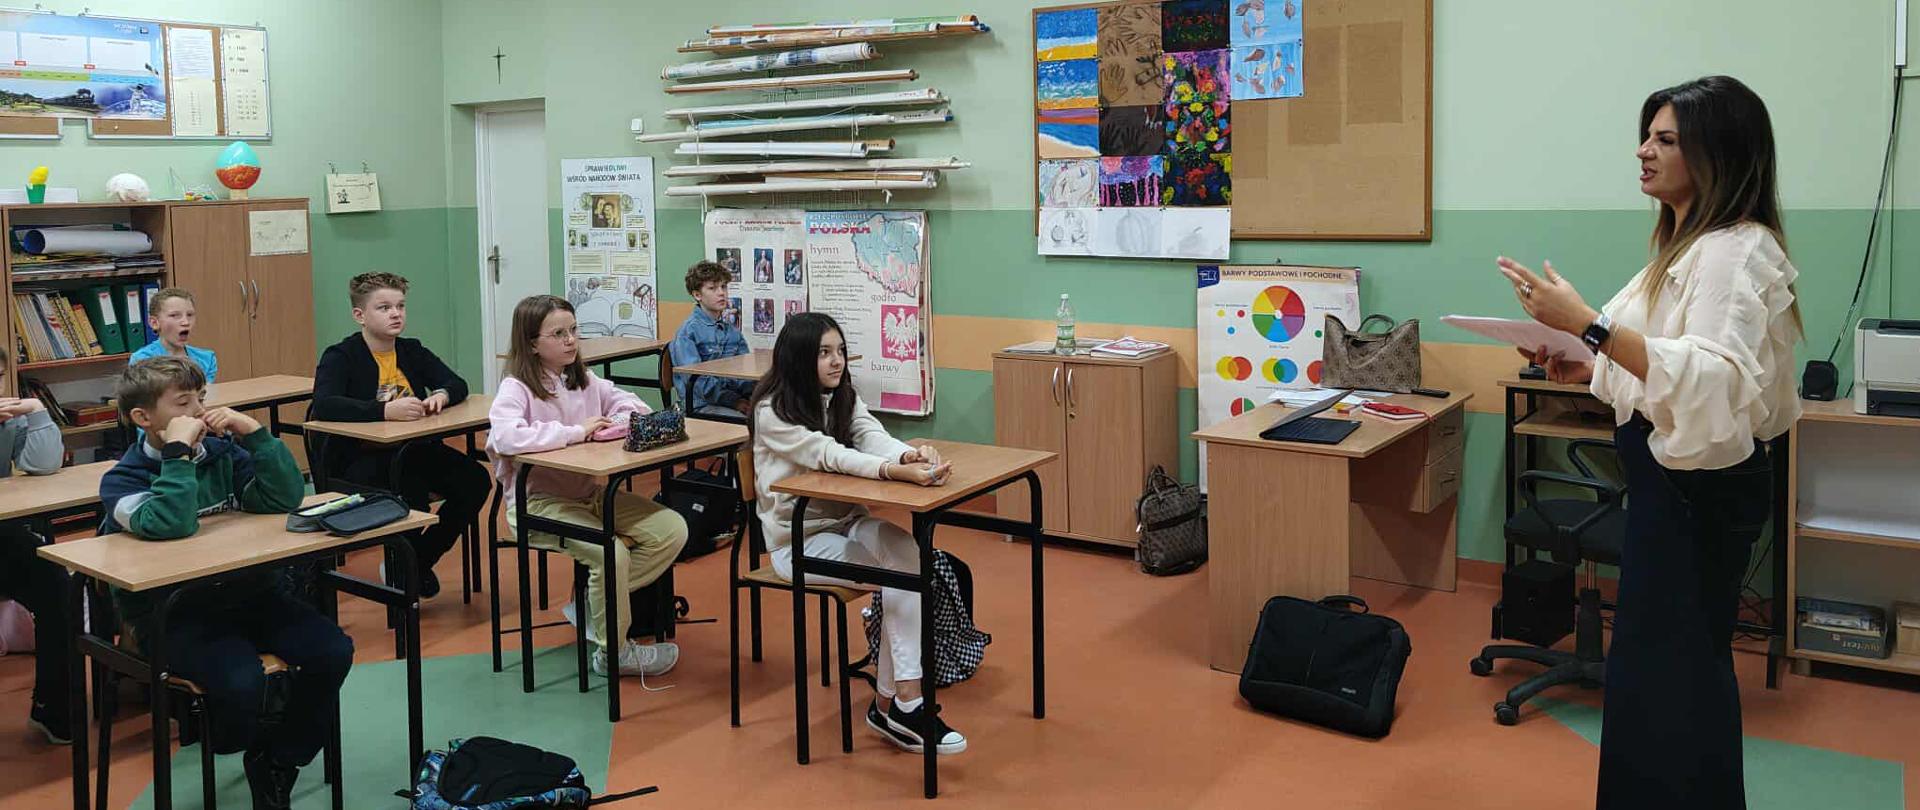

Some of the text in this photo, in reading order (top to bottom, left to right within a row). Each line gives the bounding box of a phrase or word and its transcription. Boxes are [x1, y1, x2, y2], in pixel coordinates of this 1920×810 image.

[809, 220, 872, 235] POLSKA
[809, 243, 840, 255] hymn
[1248, 270, 1298, 278] PODSTAWOWE
[871, 361, 900, 373] barwy
